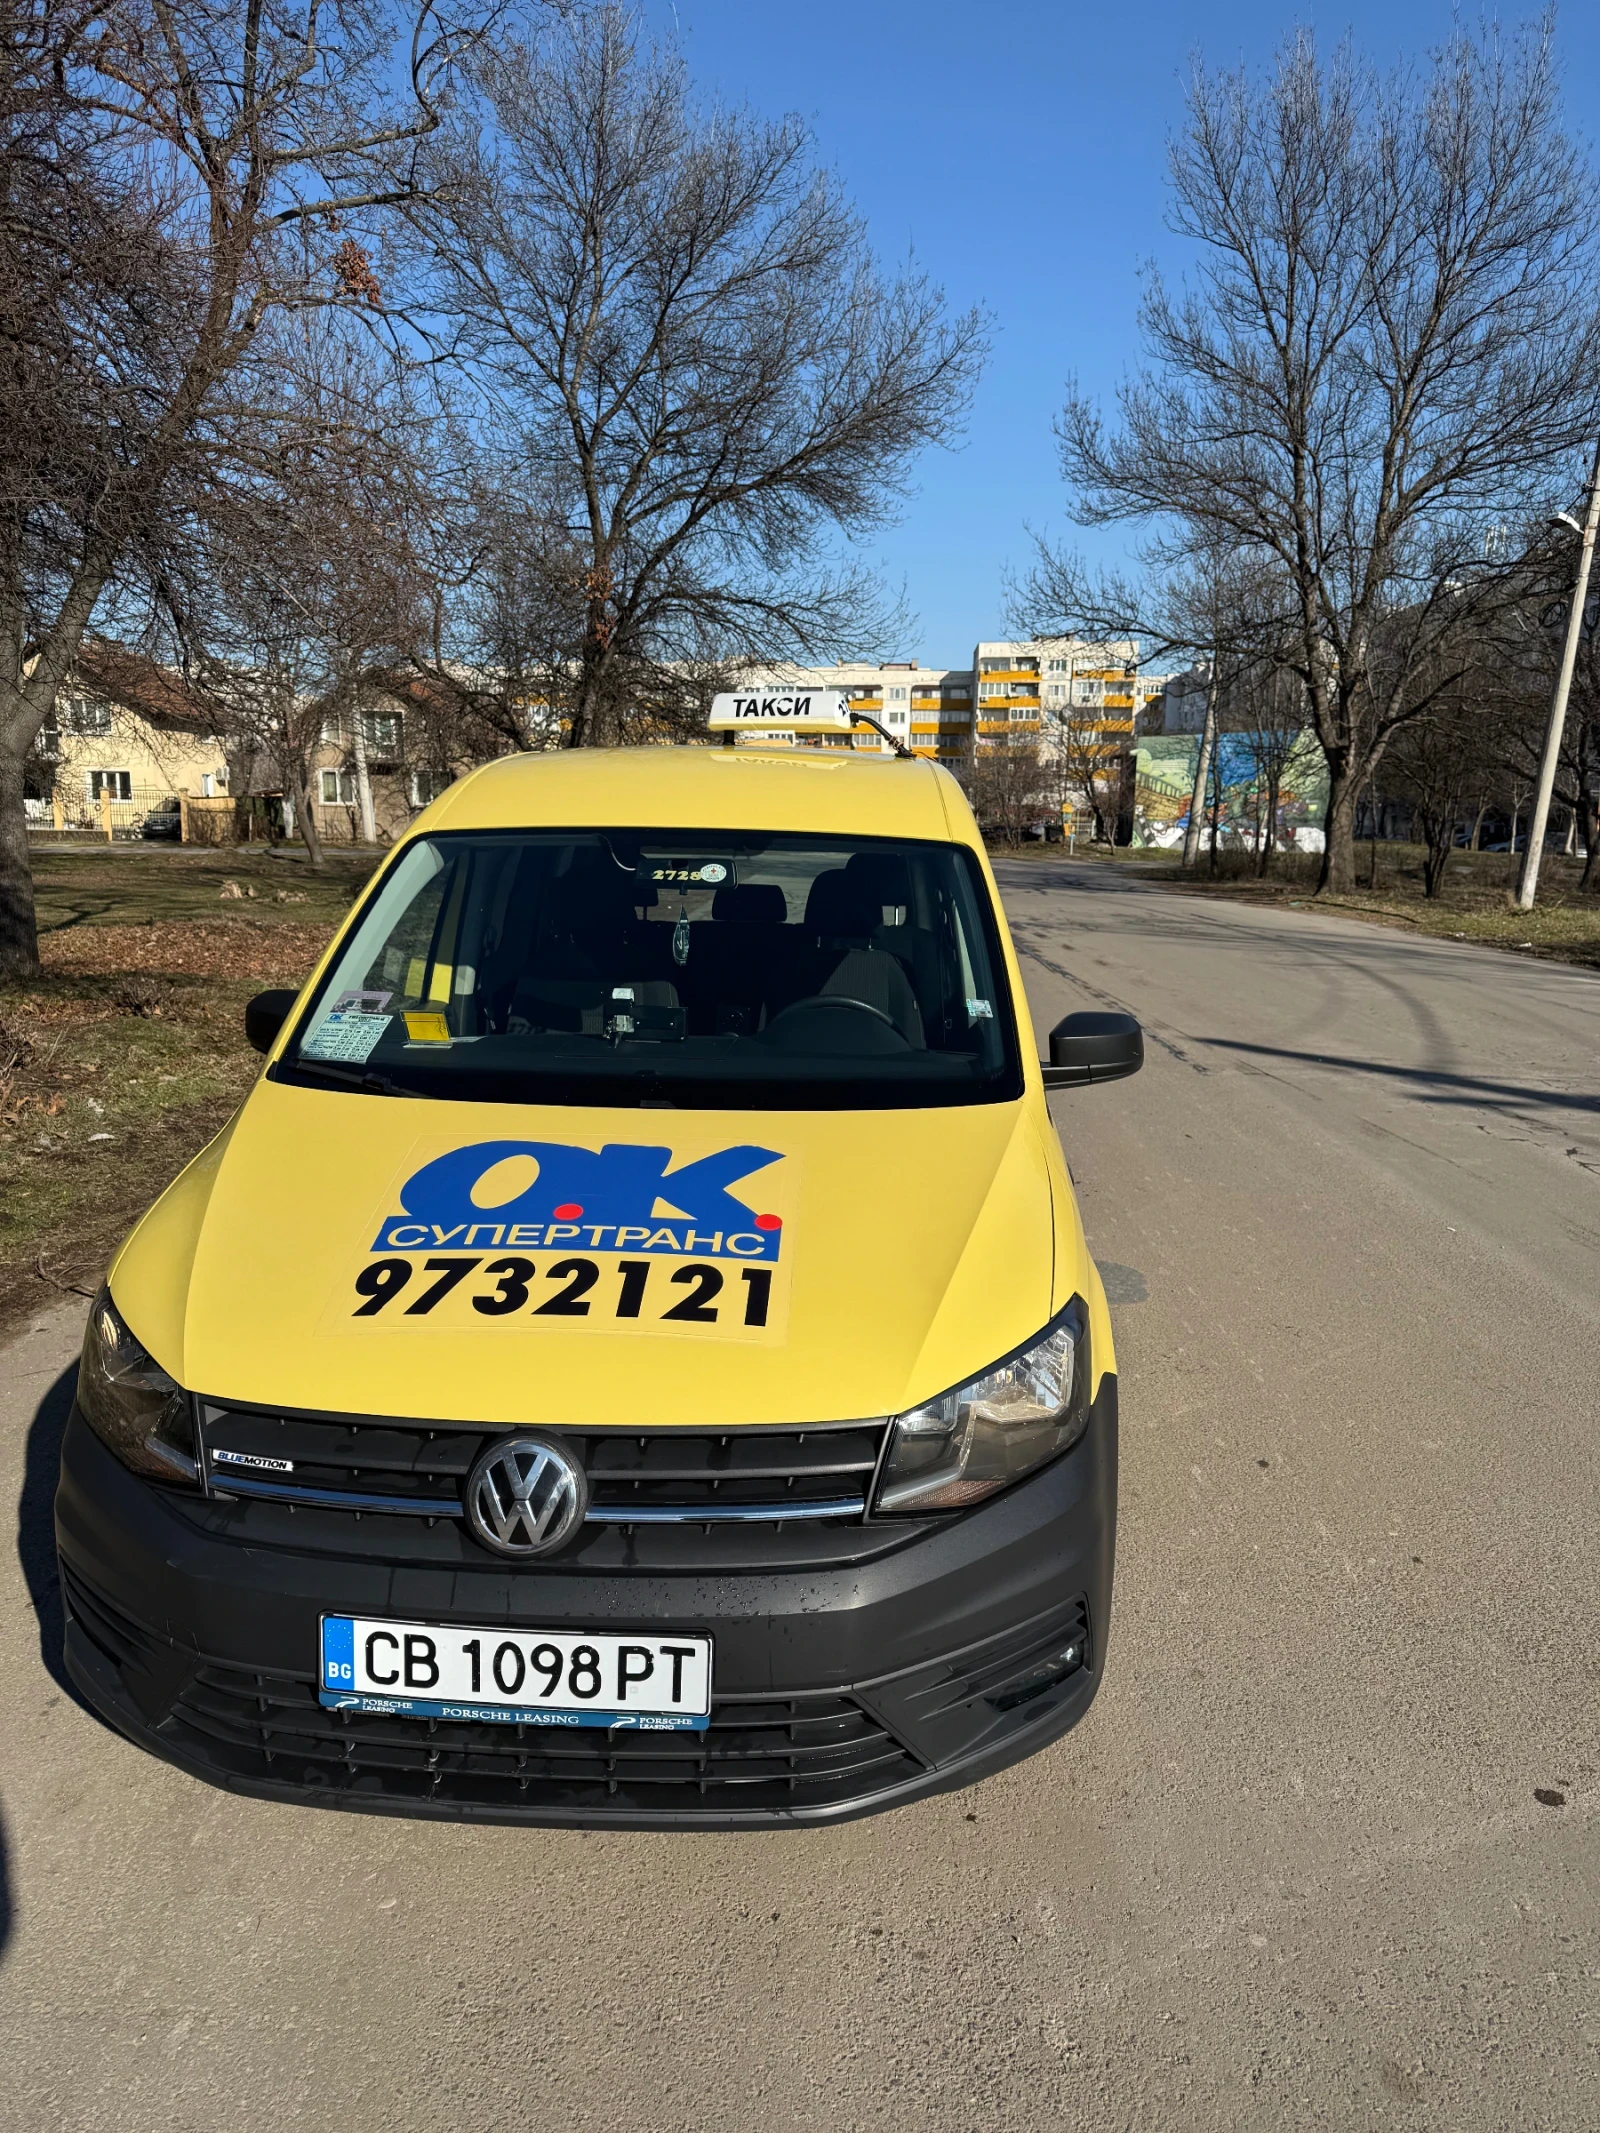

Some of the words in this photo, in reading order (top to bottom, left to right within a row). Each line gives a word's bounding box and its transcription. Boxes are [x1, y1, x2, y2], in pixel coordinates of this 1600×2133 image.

[733, 697, 811, 717] ТАКСИ
[652, 870, 702, 881] 2728
[387, 1224, 766, 1255] СУПЕРТРАНС
[351, 1257, 772, 1327] 9732121
[217, 1451, 287, 1469] BLUEMOTION
[479, 1441, 575, 1550] VW
[328, 1661, 352, 1679] BG
[364, 1631, 440, 1688] CB
[462, 1639, 600, 1698] 1098
[617, 1645, 696, 1703] PT
[362, 1698, 413, 1709] PORSCHE
[362, 1705, 396, 1713] LEASING
[442, 1708, 511, 1720] PORSCHE
[515, 1713, 579, 1724] LEASING
[639, 1717, 693, 1726] PORSCHE
